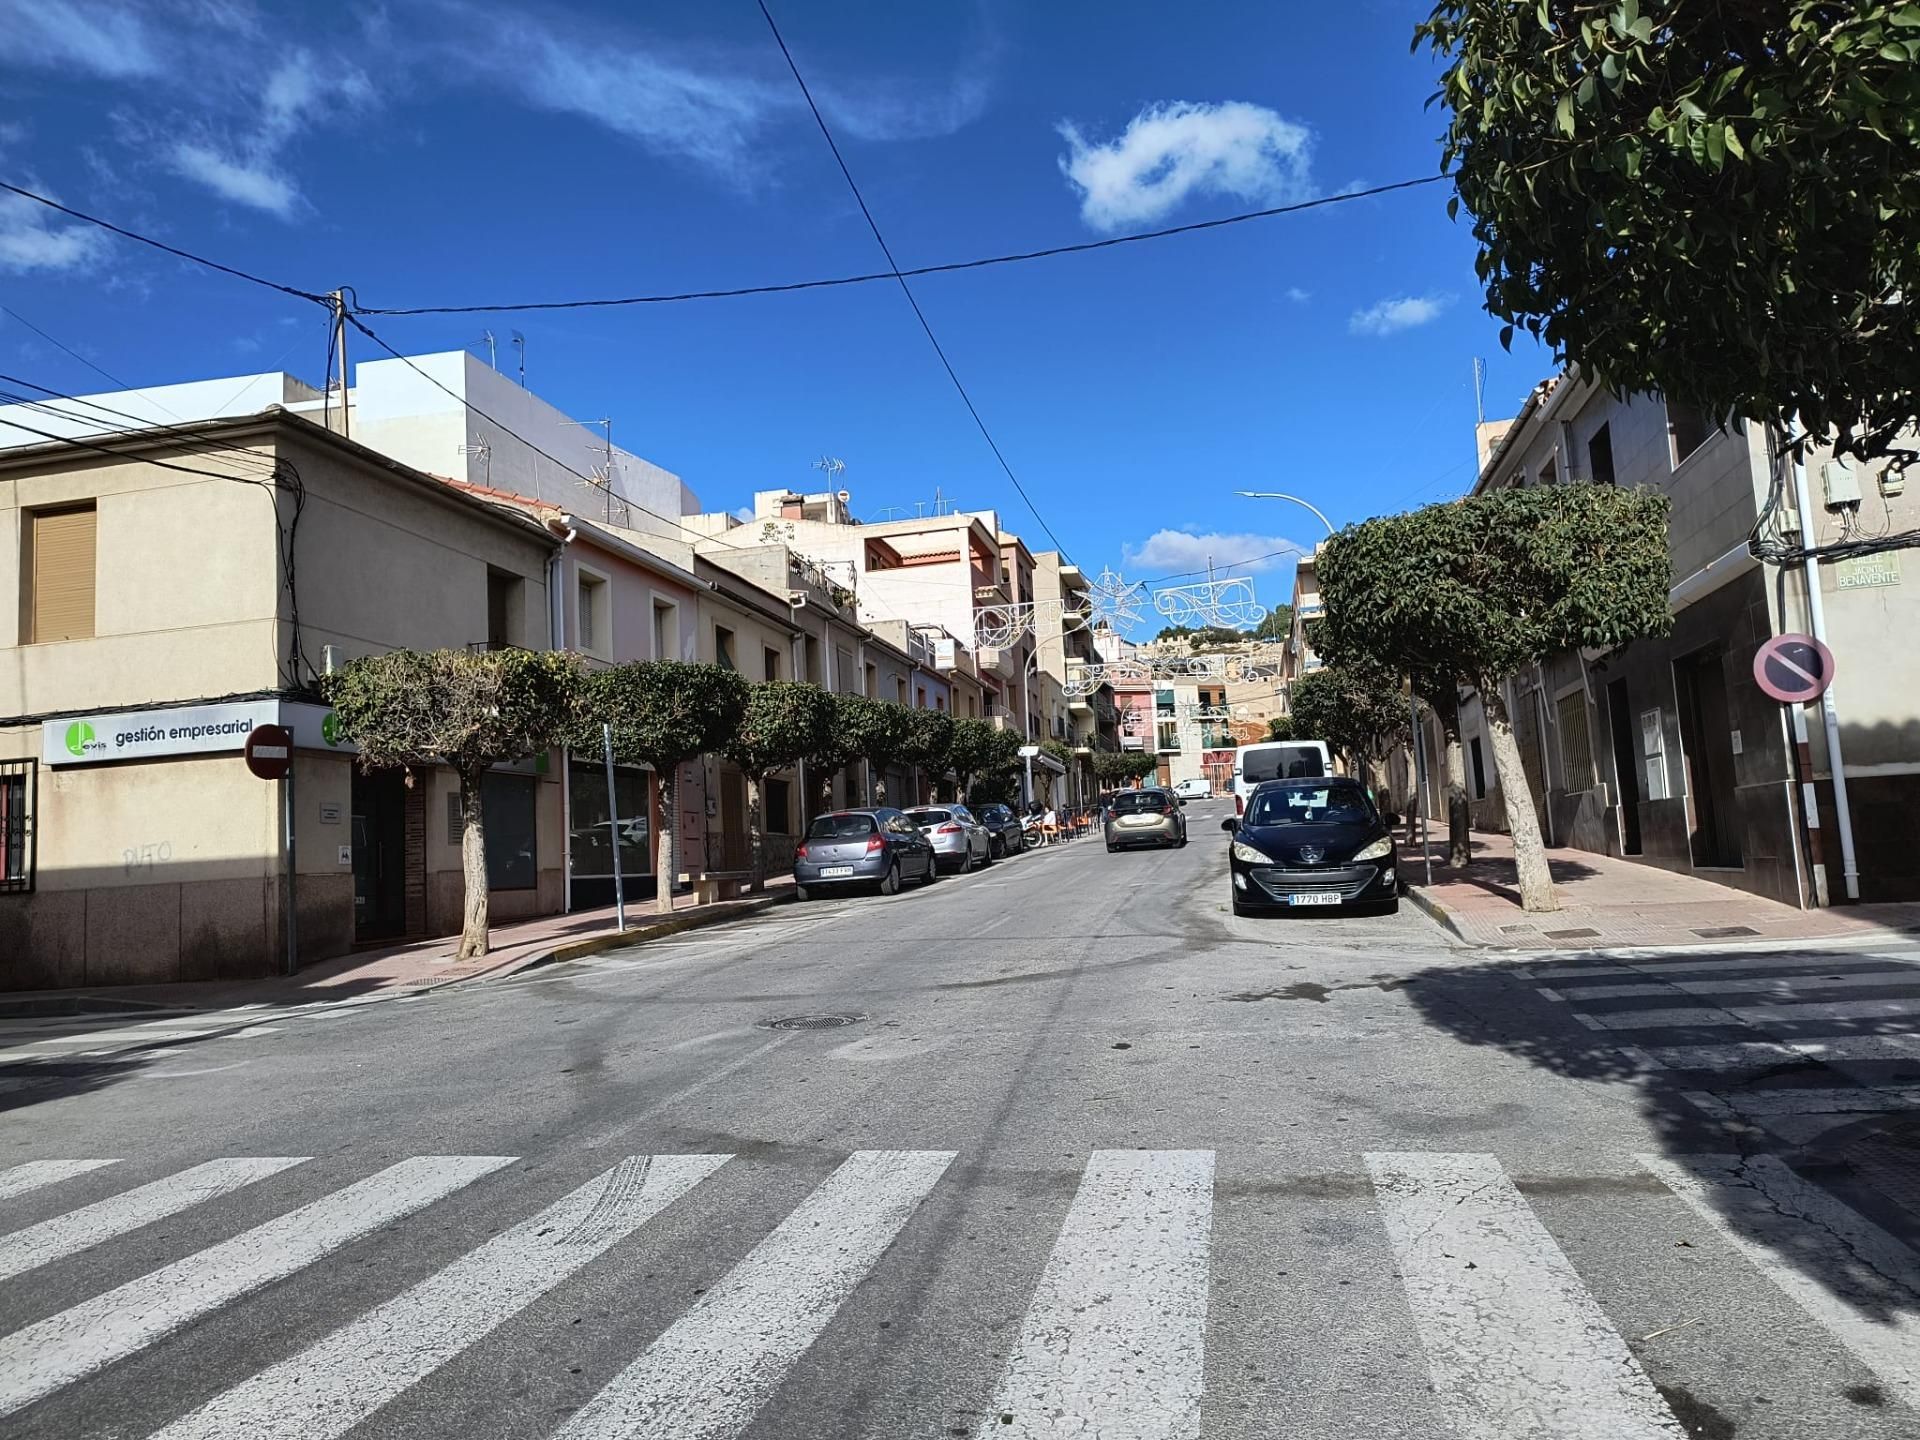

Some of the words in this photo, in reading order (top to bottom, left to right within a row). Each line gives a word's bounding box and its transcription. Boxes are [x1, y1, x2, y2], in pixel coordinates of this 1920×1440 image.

[1839, 570, 1899, 587] BENAVENTE
[115, 725, 166, 747] gestión
[168, 718, 253, 740] empresarial
[1296, 895, 1319, 904] 1770
[1321, 894, 1340, 903] HBP
